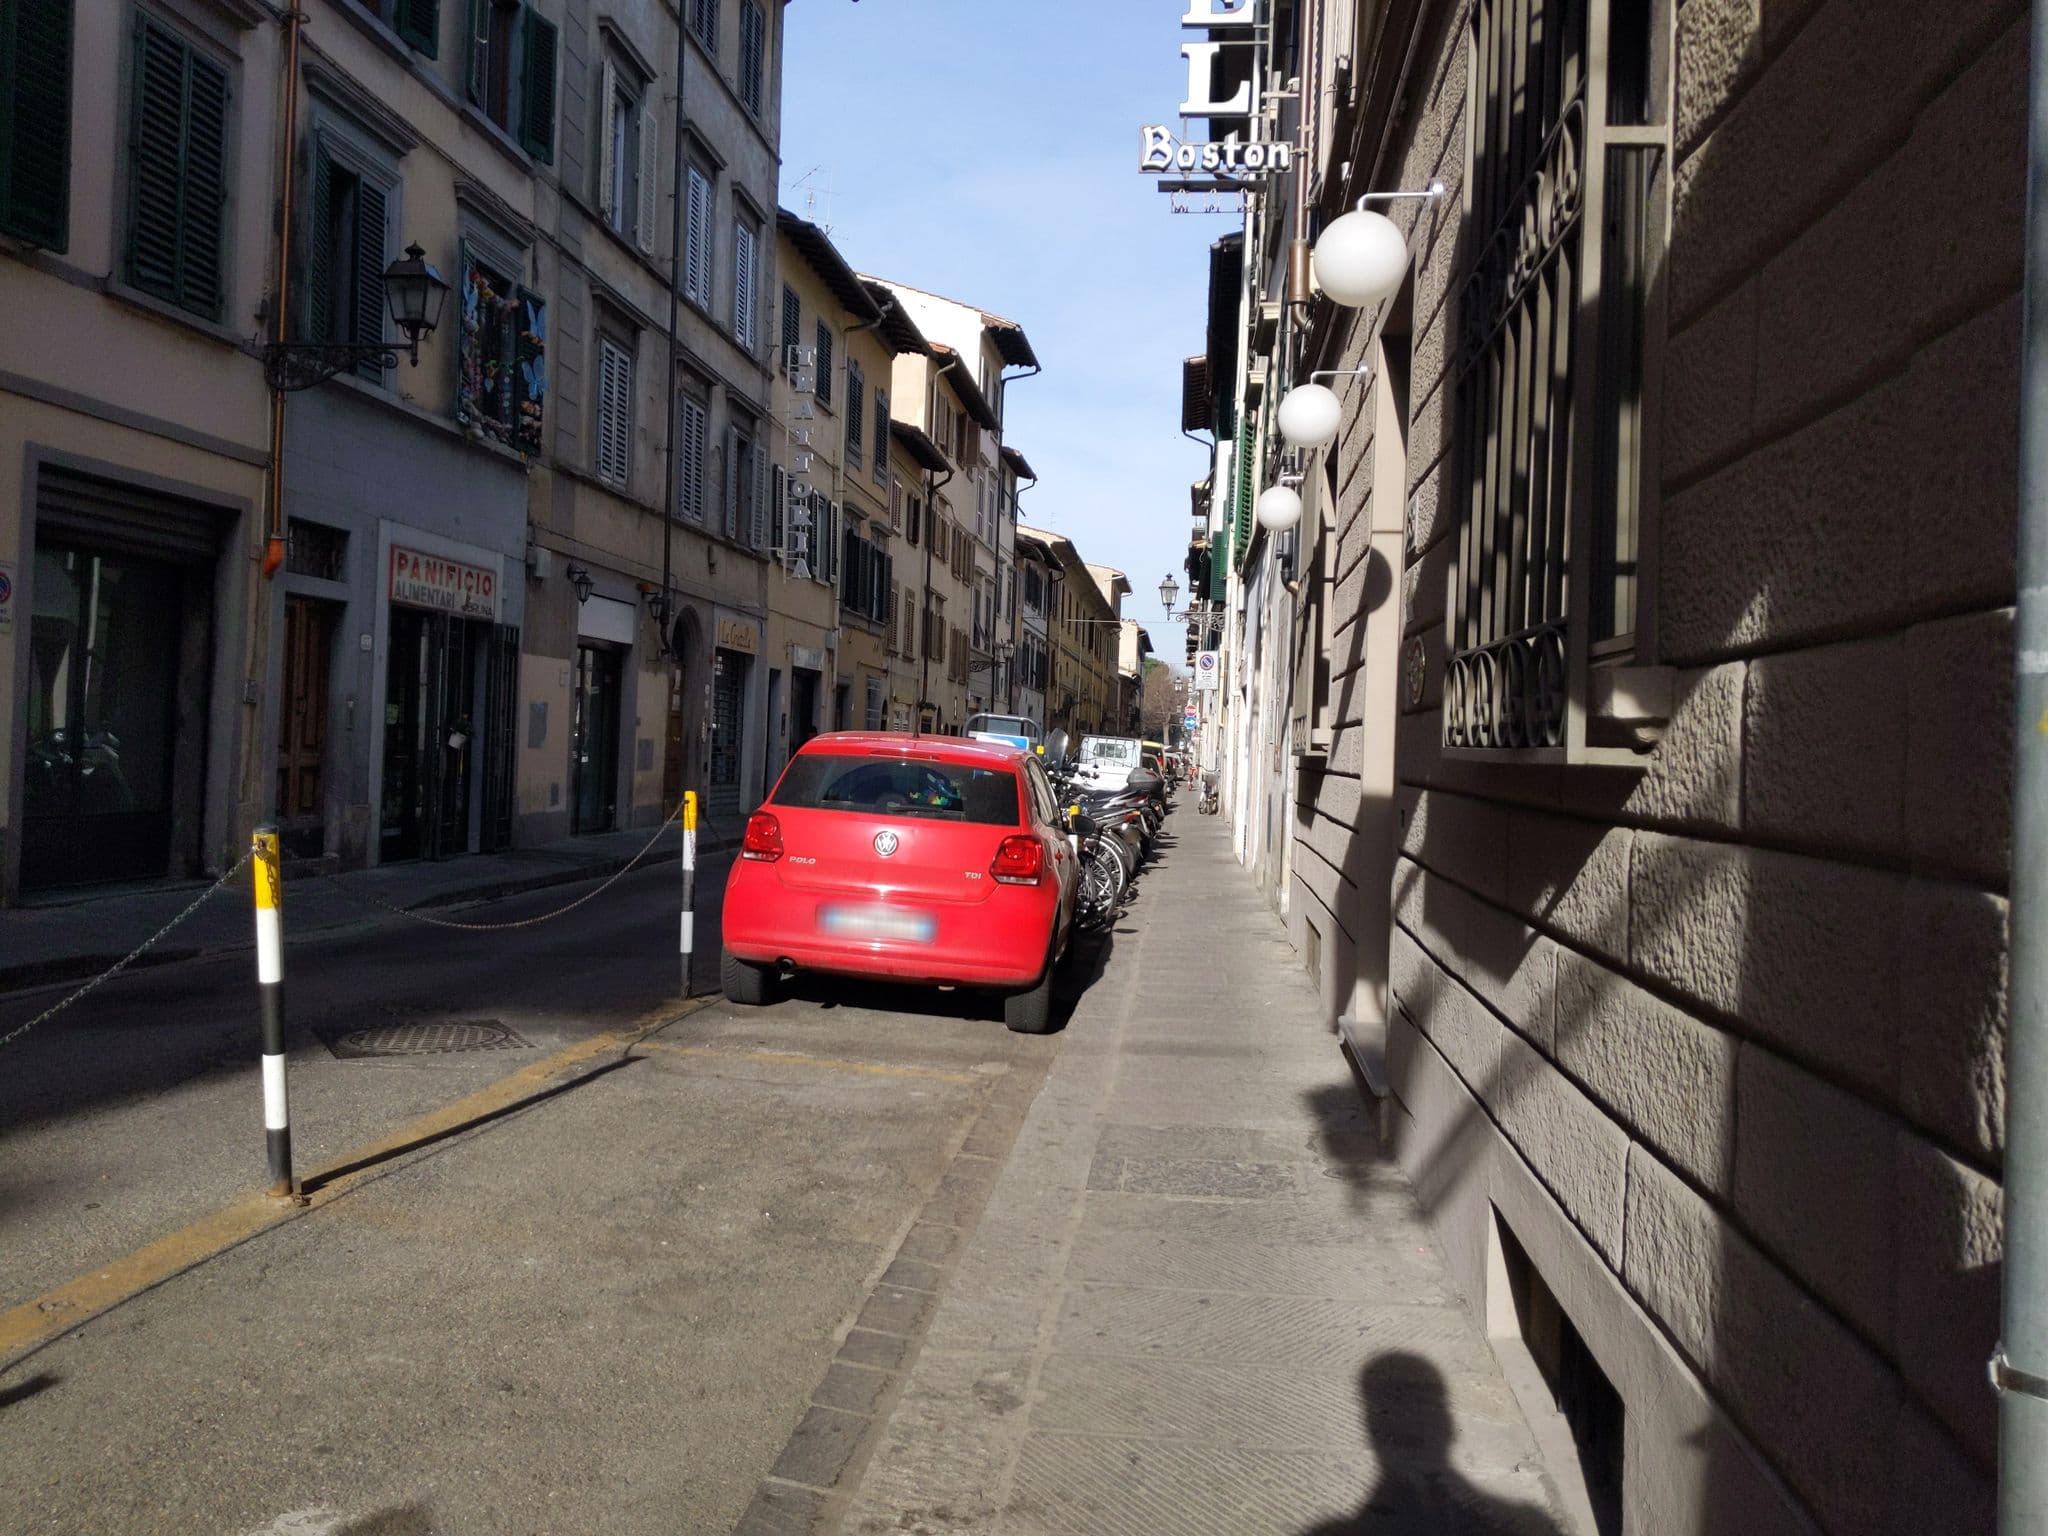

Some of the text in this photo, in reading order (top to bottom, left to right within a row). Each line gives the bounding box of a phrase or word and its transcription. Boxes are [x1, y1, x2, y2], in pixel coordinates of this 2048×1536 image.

[1142, 125, 1290, 171] Boston
[792, 346, 817, 578] TRATTORIA
[397, 552, 492, 596] PANIFICIO
[395, 580, 455, 608] ALIMENTARI
[789, 855, 816, 865] POLO
[965, 872, 982, 880] TDI
